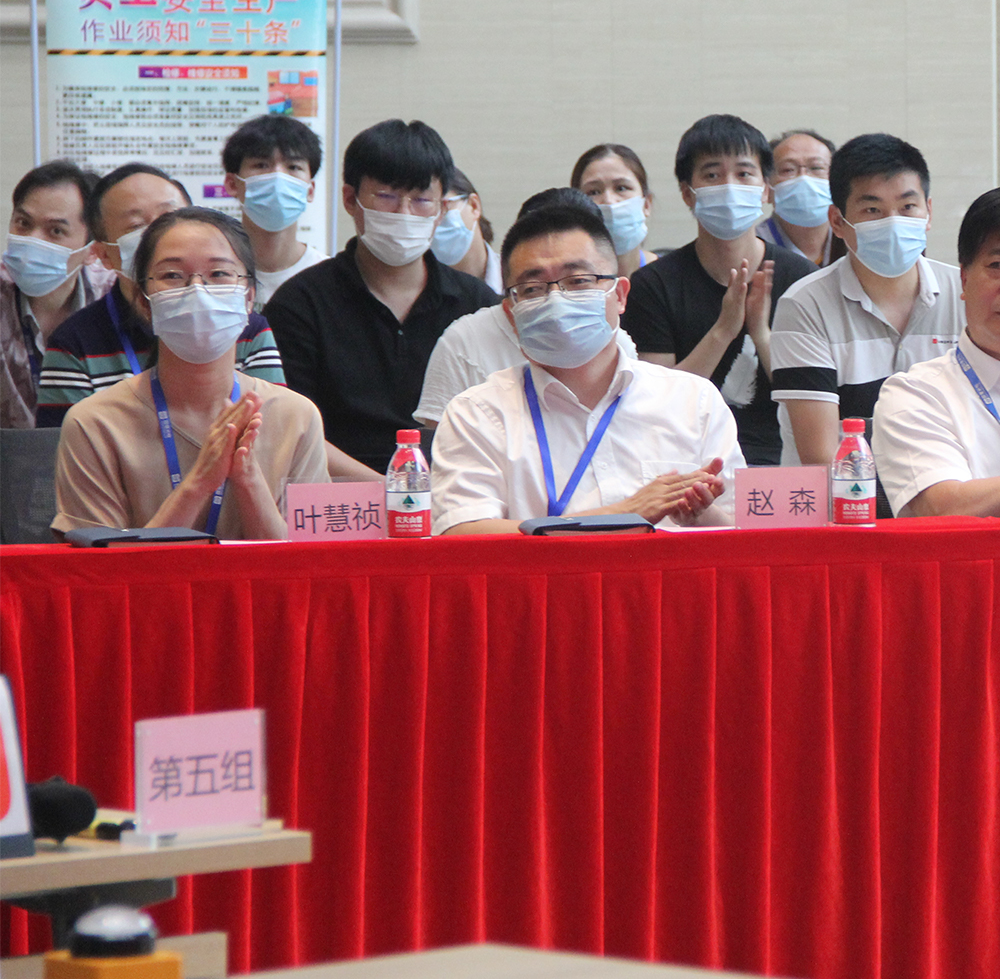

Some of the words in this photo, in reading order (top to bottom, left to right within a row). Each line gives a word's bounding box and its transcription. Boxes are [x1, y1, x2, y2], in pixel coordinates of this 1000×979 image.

[294, 501, 382, 534] 叶慧祯
[149, 749, 256, 802] 第五组
